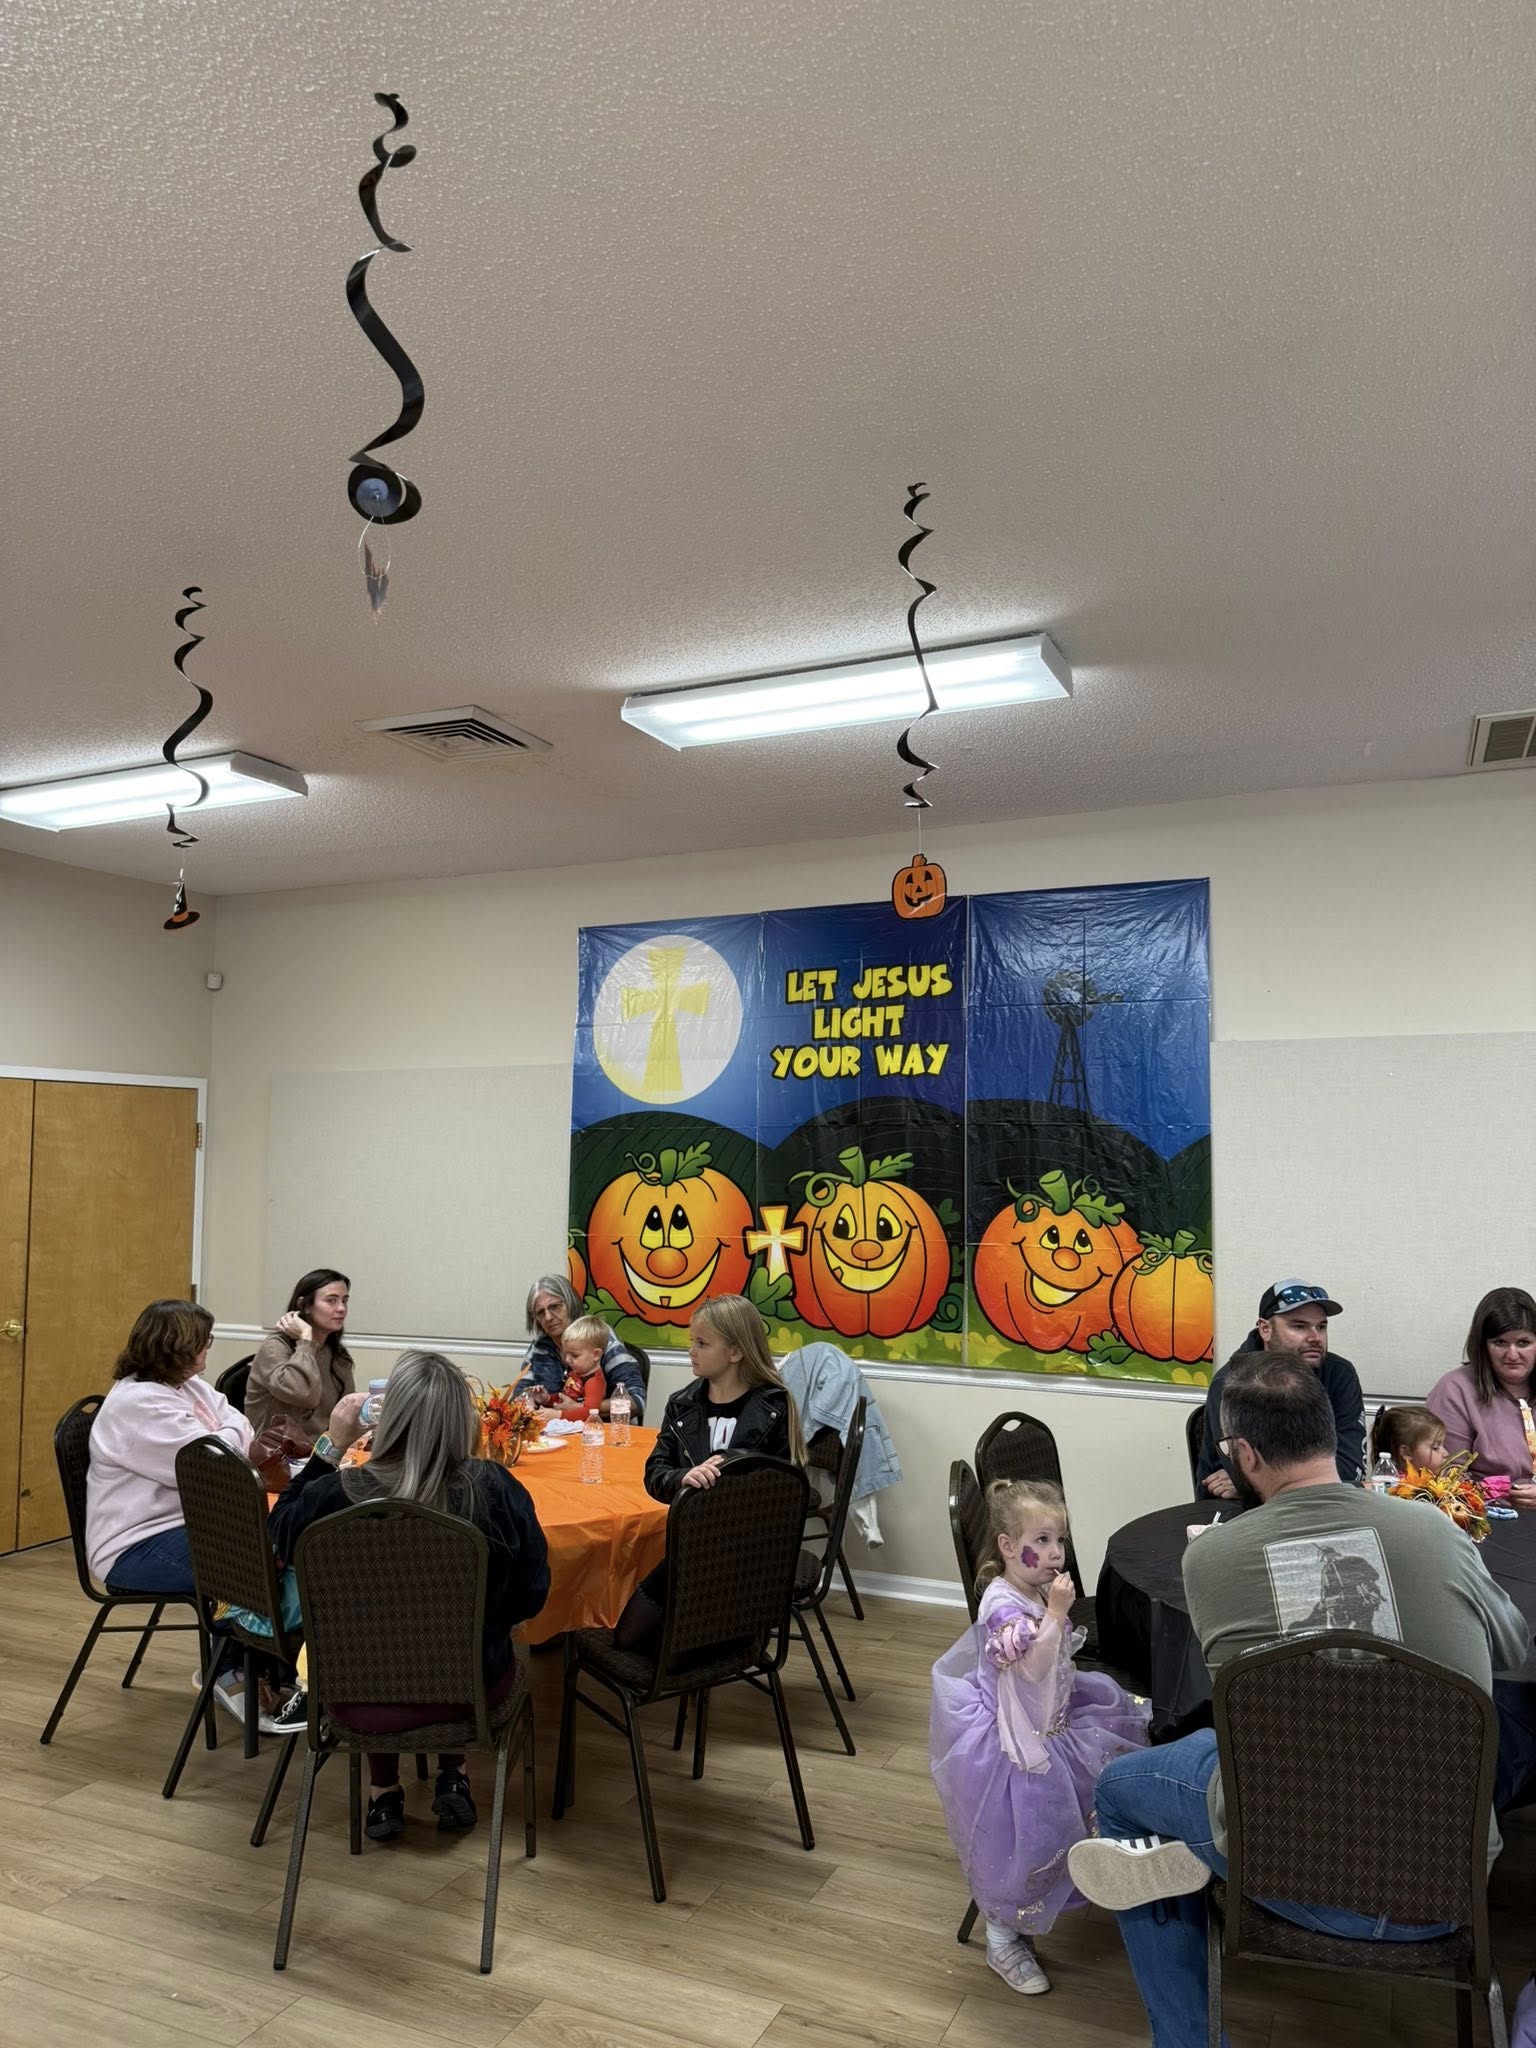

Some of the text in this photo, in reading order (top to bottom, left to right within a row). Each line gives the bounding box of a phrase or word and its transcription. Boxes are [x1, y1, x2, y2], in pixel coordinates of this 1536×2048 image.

[787, 963, 953, 1003] LET JESUS
[813, 1004, 905, 1039] LIGHT
[771, 1043, 950, 1078] YOUR WAY
